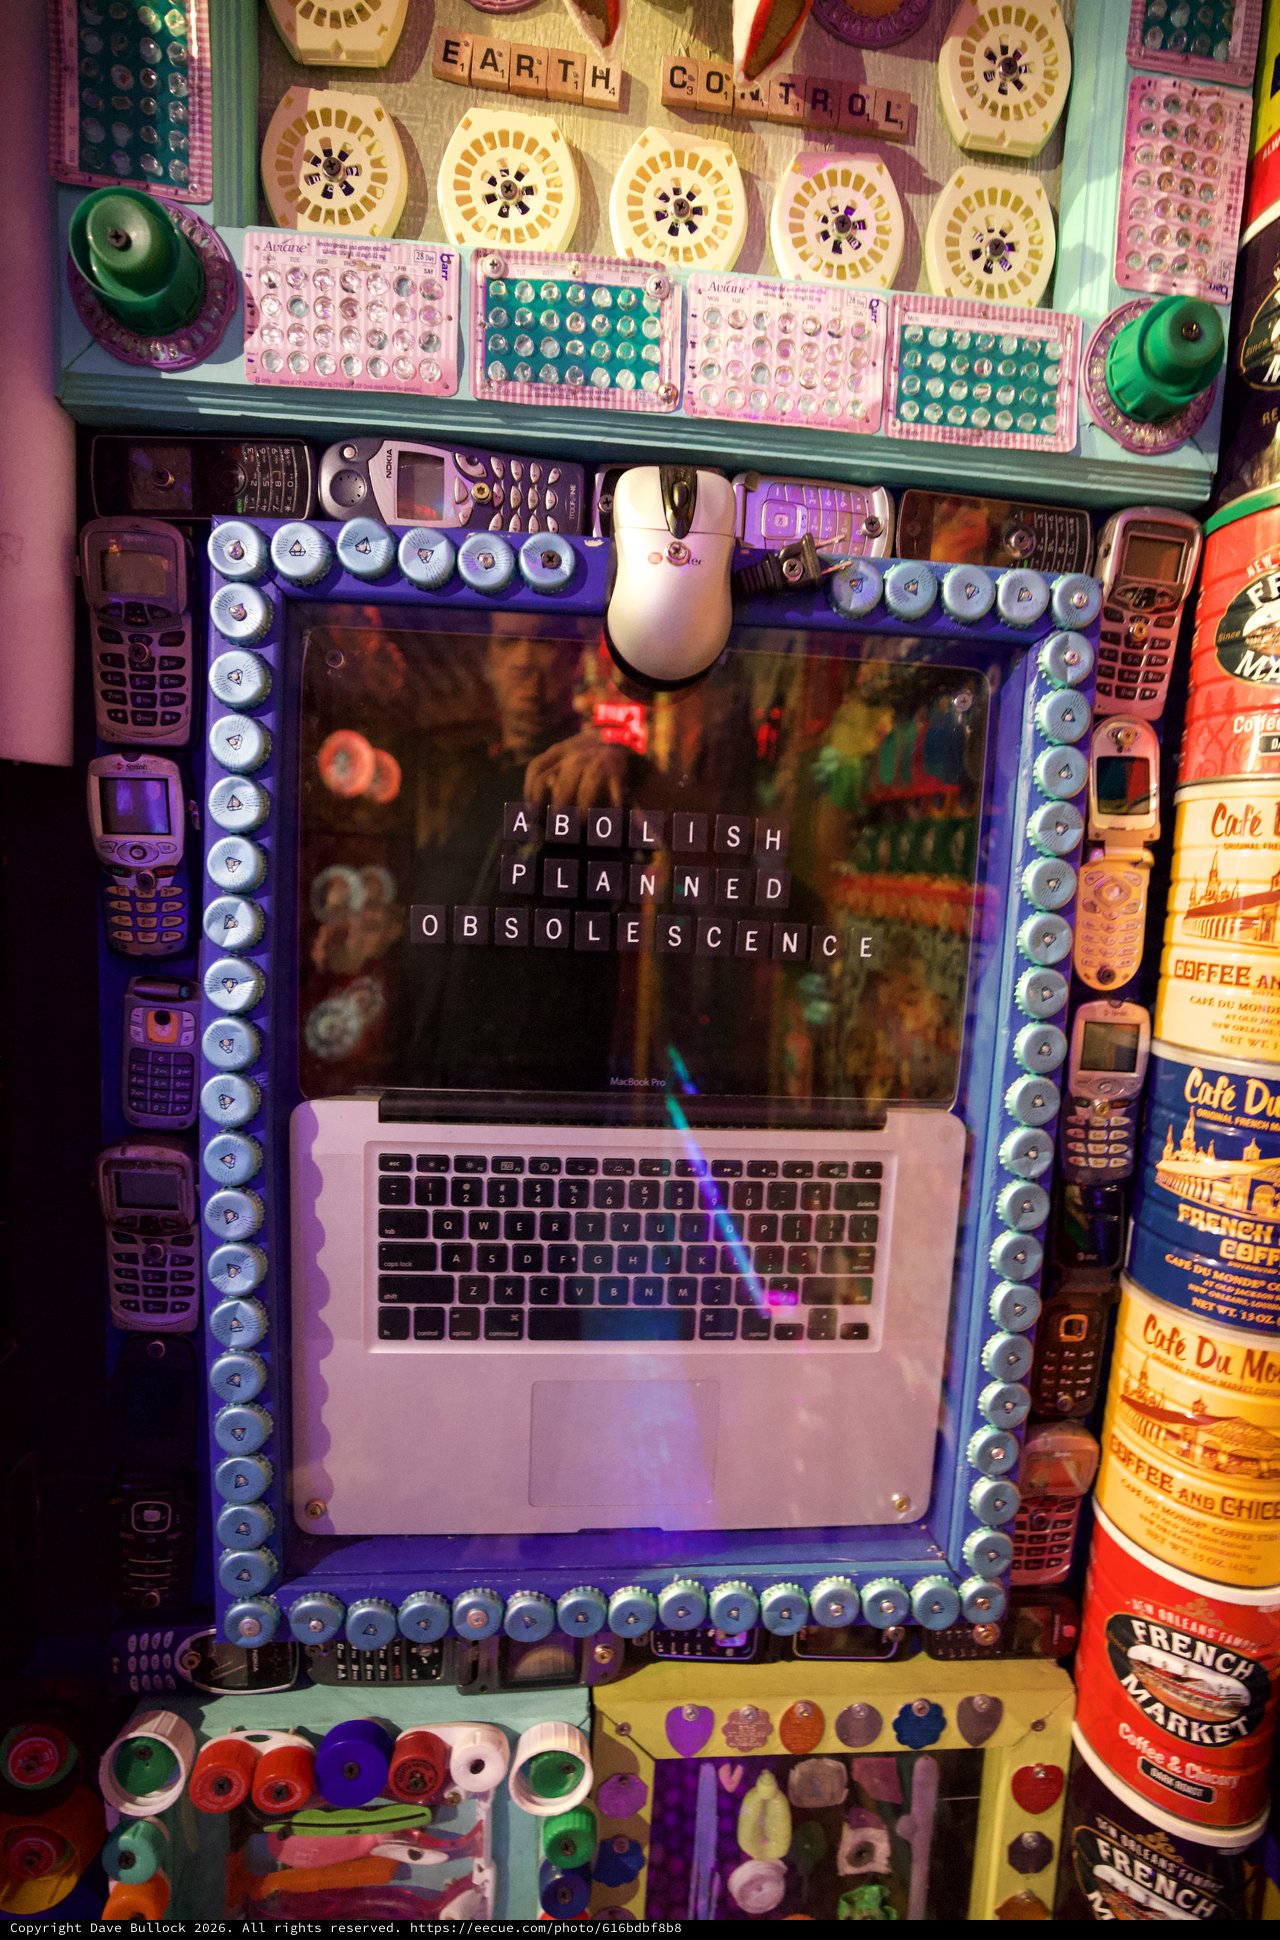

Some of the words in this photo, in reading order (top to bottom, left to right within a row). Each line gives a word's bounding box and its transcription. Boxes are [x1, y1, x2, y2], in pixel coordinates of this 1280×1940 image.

[442, 39, 611, 90] EARTH
[263, 238, 307, 253] Aviane
[415, 251, 424, 260] 28
[440, 253, 455, 281] barr
[708, 279, 748, 295] Aviane
[1211, 802, 1263, 839] Café
[512, 812, 781, 850] ABOLISH
[512, 864, 782, 900] PLANNED
[422, 914, 873, 959] OBSOLESCENCE
[1174, 959, 1252, 987] COFFEE
[1189, 995, 1216, 1007] CAFÉ
[1217, 999, 1235, 1009] DU
[1220, 1034, 1244, 1046] NET
[610, 1076, 650, 1086] MacBook
[651, 1078, 666, 1087] Pro
[1184, 1066, 1237, 1112] Café
[388, 1160, 401, 1168] esc
[463, 1193, 470, 1203] 2
[498, 1194, 506, 1204] 3
[534, 1194, 542, 1204] 4
[569, 1196, 577, 1205] 5
[605, 1196, 613, 1205] 6
[641, 1197, 648, 1206] 7
[676, 1197, 683, 1206] 8
[745, 1198, 753, 1207] 0
[856, 1200, 876, 1208] delete
[443, 1221, 453, 1231] Q
[478, 1221, 489, 1231] W
[516, 1222, 523, 1232] E
[551, 1222, 559, 1232] R
[586, 1223, 594, 1232] T
[621, 1223, 630, 1233] Y
[656, 1224, 665, 1233] U
[760, 1224, 768, 1233] P
[1177, 1202, 1274, 1245] FRENCH
[726, 1224, 735, 1234] O
[452, 1254, 461, 1263] A
[488, 1254, 496, 1264] S
[523, 1255, 532, 1264] D
[560, 1255, 566, 1264] F
[593, 1255, 603, 1265] G
[628, 1256, 638, 1265] H
[664, 1256, 671, 1266] J
[698, 1256, 706, 1266] K
[398, 1260, 413, 1268] lock
[1164, 1253, 1193, 1271] CAFÉ
[1193, 1263, 1212, 1277] DU
[470, 1286, 477, 1296] Z
[504, 1287, 513, 1296] X
[540, 1287, 548, 1296] C
[575, 1287, 584, 1297] V
[610, 1287, 618, 1297] B
[644, 1288, 653, 1297] N
[678, 1288, 688, 1297] M
[383, 1293, 398, 1301] shift
[1191, 1296, 1217, 1312] NET
[451, 1330, 473, 1338] option
[488, 1329, 519, 1337] command
[1143, 1313, 1187, 1362] Café
[1195, 1335, 1233, 1376] Du
[1111, 1434, 1175, 1494] COFFEE
[1177, 1487, 1215, 1511] AND
[1130, 1618, 1256, 1682] FRENCH
[1119, 1673, 1251, 1745] MARKET
[1118, 1722, 1165, 1765] Coffee
[1166, 1755, 1183, 1774] &
[1095, 1837, 1218, 1919] FRENCH
